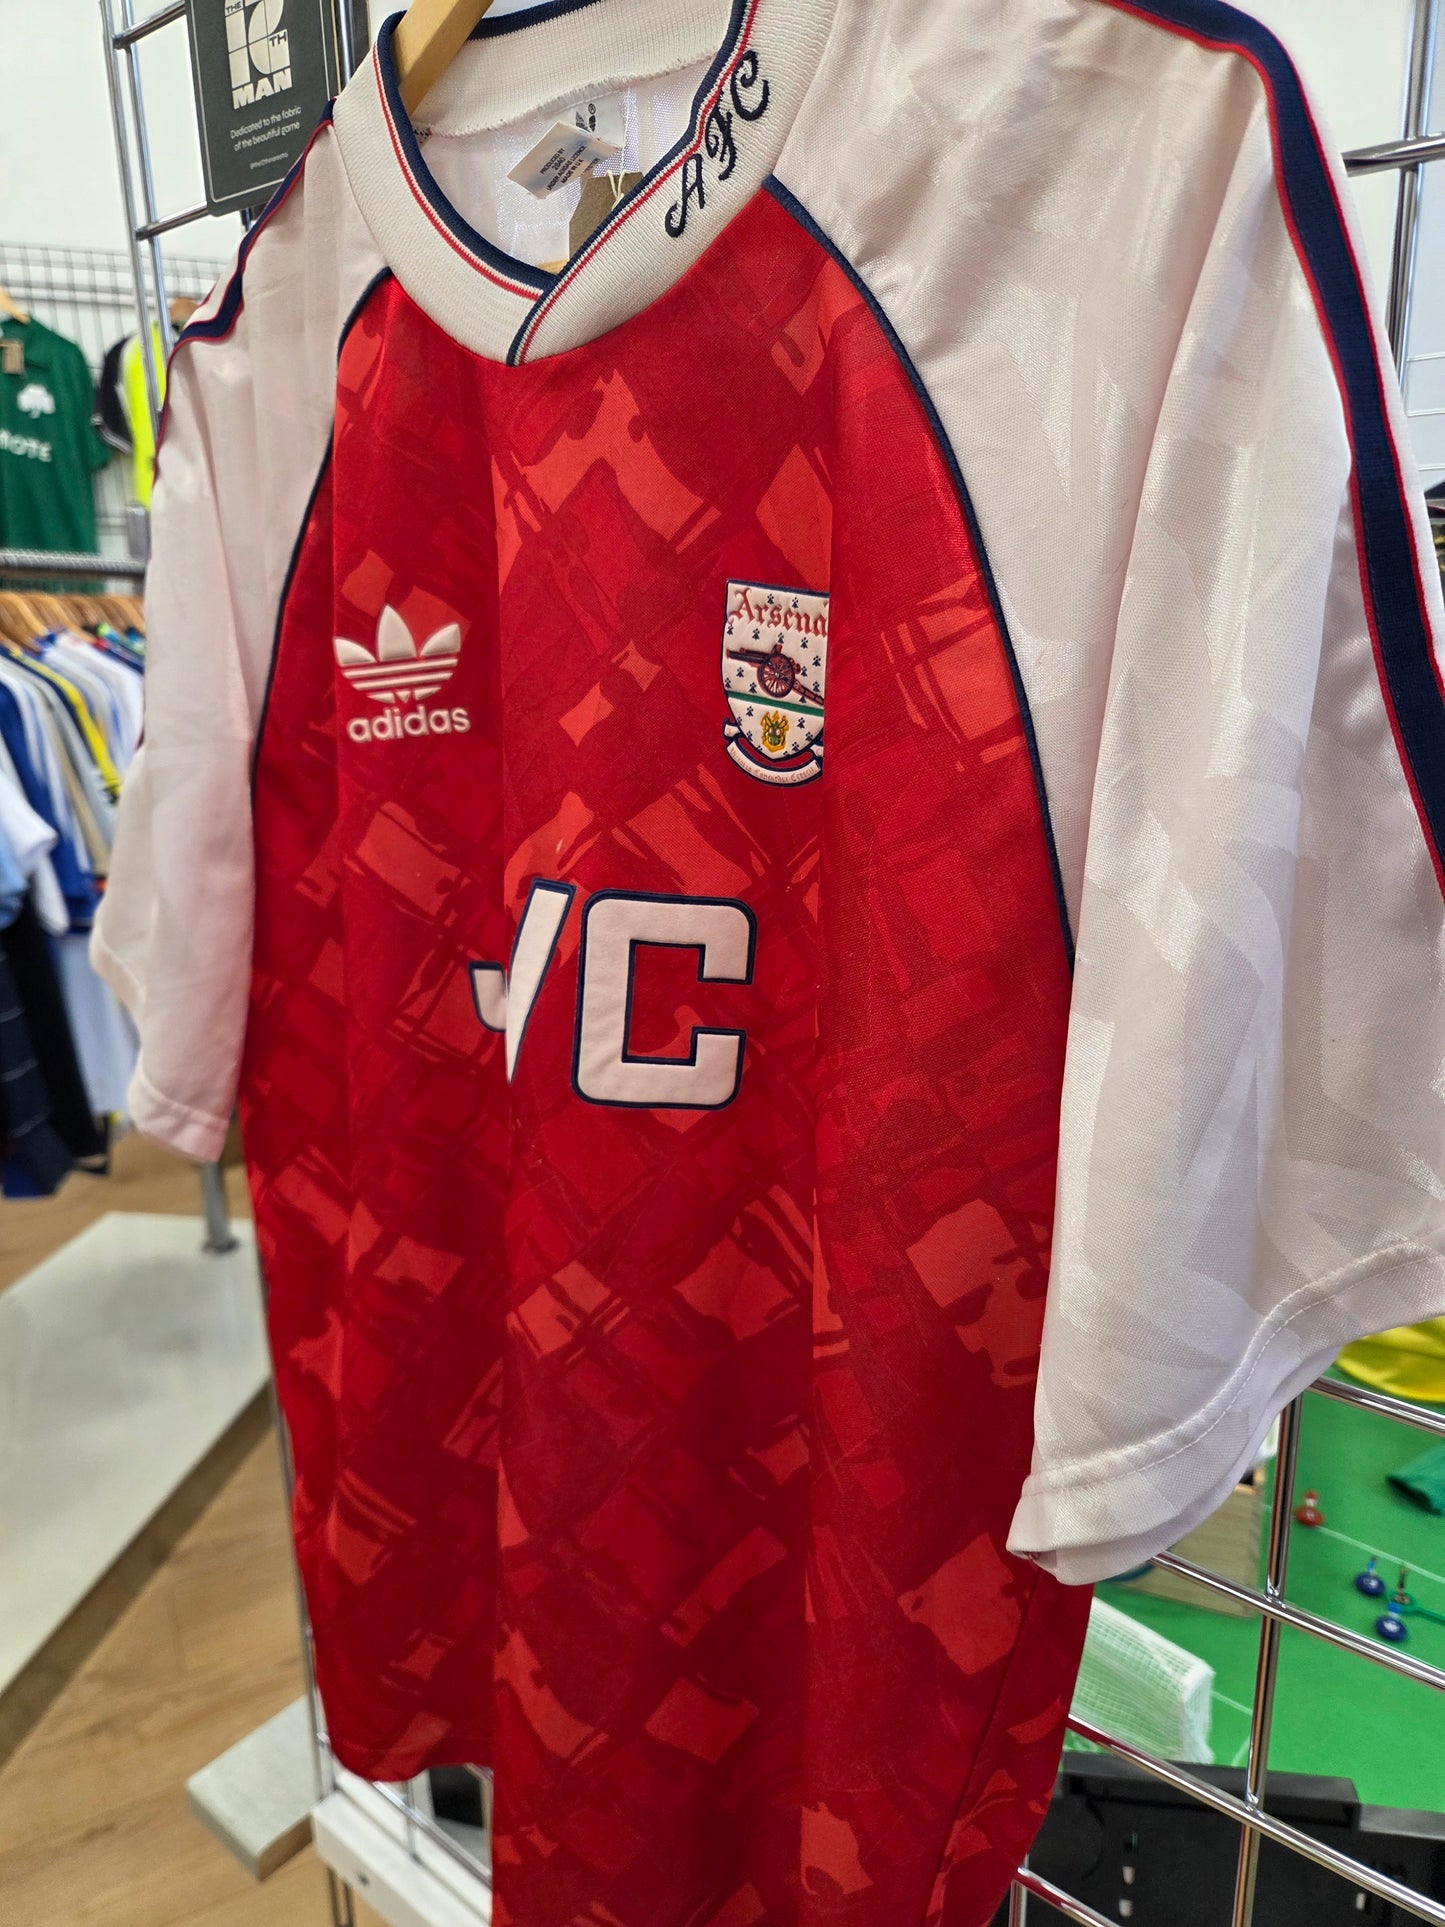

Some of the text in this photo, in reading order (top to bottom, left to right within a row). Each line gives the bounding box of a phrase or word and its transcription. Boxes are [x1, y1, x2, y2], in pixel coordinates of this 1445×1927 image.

[225, 1, 242, 13] THE
[232, 67, 293, 110] MAN
[230, 105, 302, 139] Dedicated to the fabric
[234, 121, 301, 152] of the beautiful game
[665, 50, 770, 238] AFC
[540, 153, 560, 174] PRODUCED
[546, 175, 559, 191] UNDER
[558, 160, 573, 178] ADIDAS
[561, 170, 573, 184] MADE
[728, 588, 829, 638] Arsena
[347, 704, 471, 743] adidas
